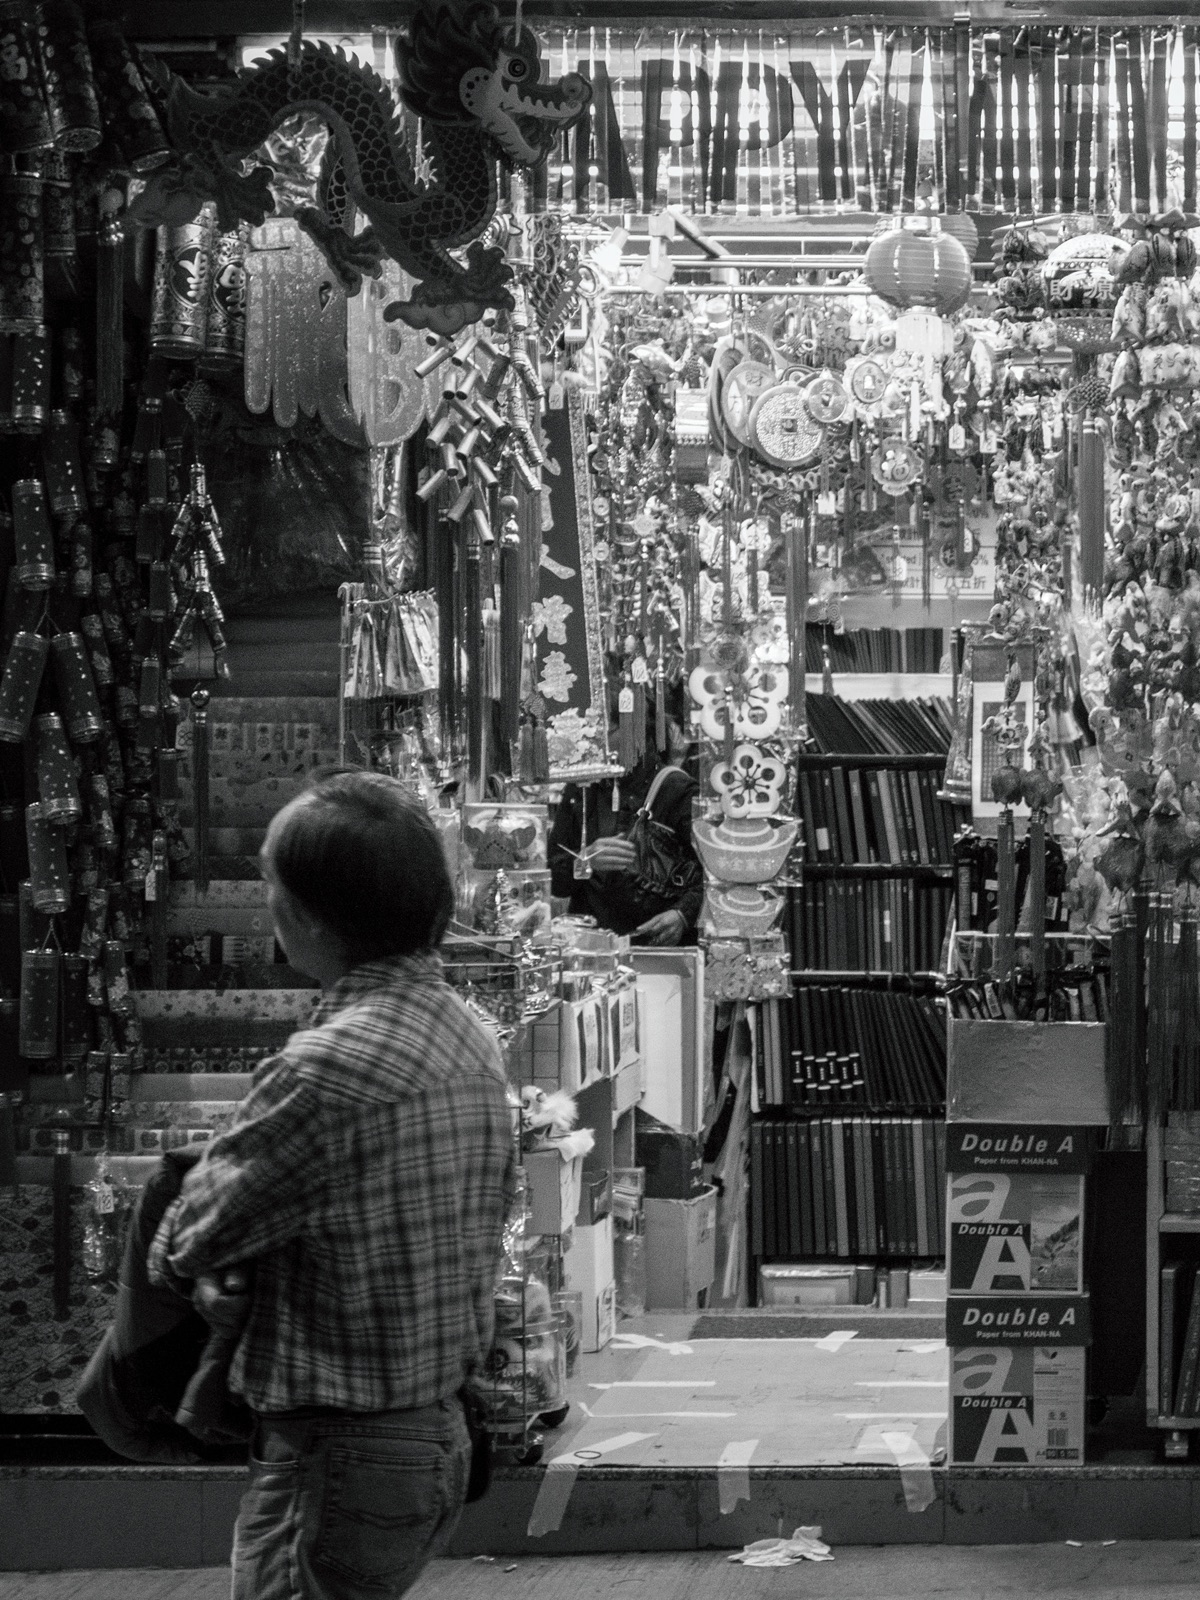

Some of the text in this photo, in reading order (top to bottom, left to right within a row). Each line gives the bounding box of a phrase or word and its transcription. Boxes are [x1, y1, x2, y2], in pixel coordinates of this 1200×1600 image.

[541, 58, 873, 201] APPY
[960, 1133, 1074, 1153] Double A
[974, 1156, 1059, 1166] Paper from KHAN-NA
[957, 1223, 1025, 1236] Double A
[970, 1236, 1032, 1290] A
[962, 1307, 1076, 1326] Double A
[976, 1330, 1062, 1339] Paper from KHAN-NA
[961, 1396, 1028, 1408] Double A
[974, 1408, 1034, 1463] A
